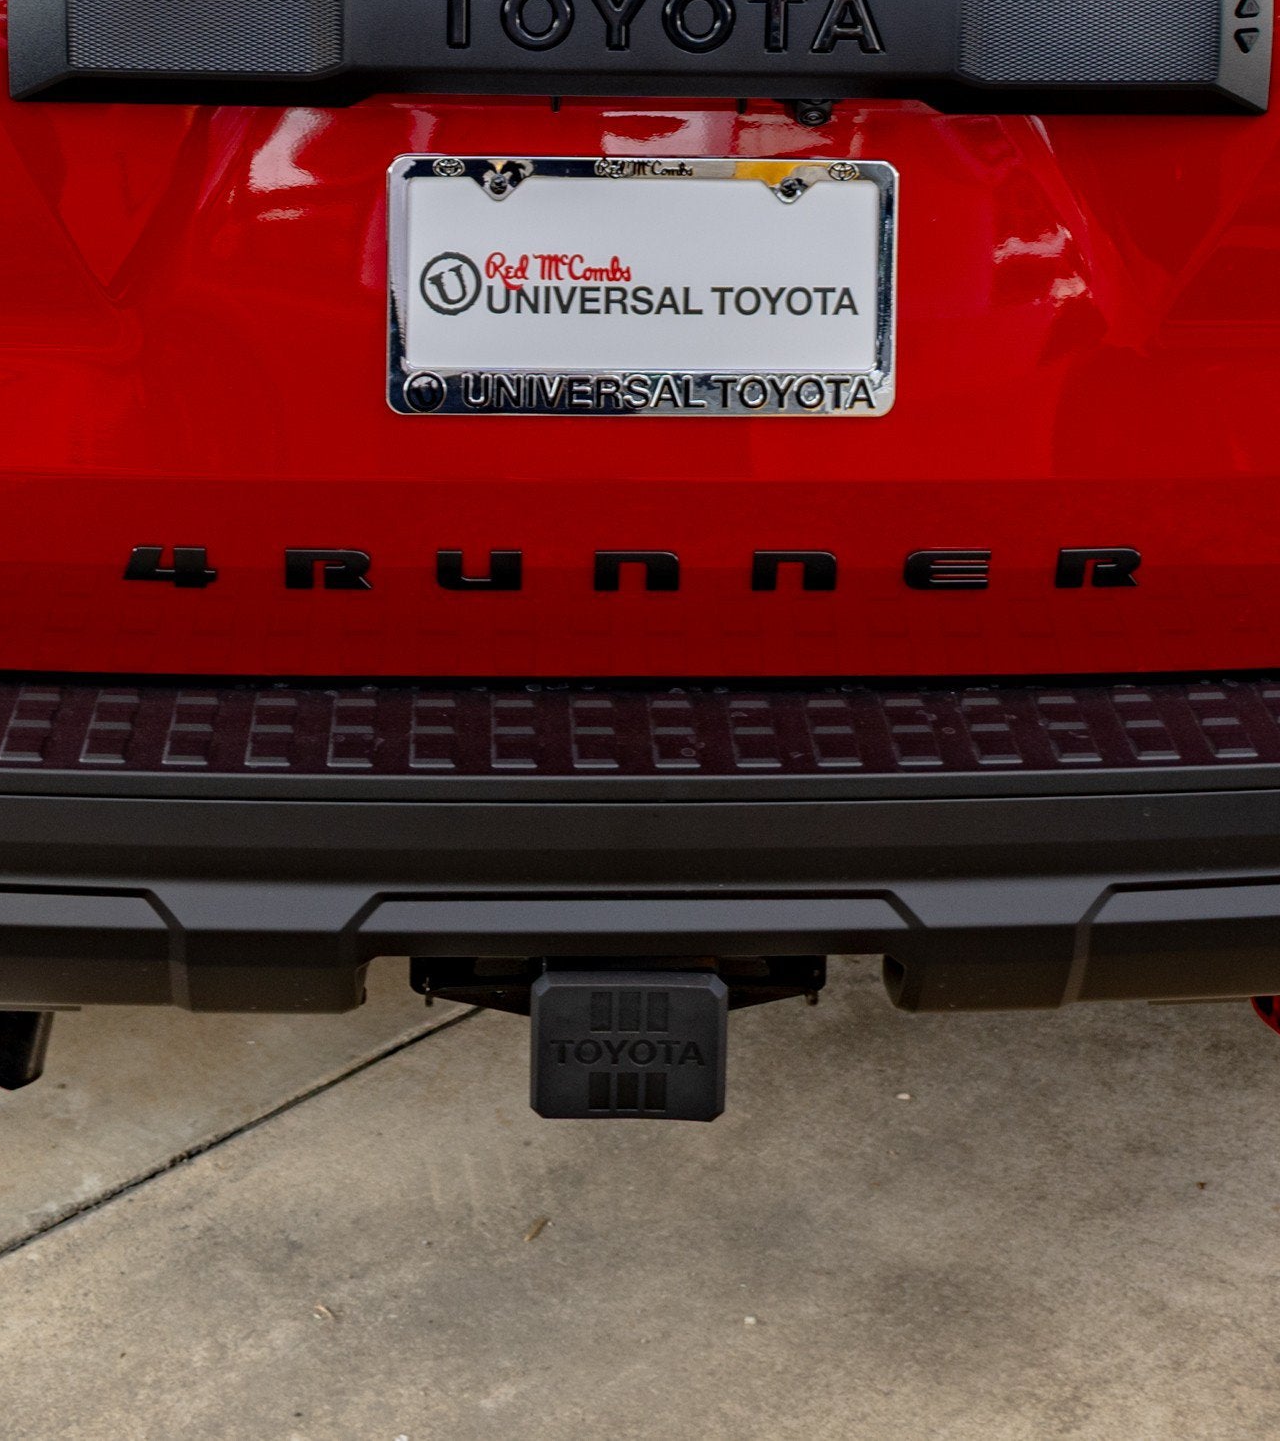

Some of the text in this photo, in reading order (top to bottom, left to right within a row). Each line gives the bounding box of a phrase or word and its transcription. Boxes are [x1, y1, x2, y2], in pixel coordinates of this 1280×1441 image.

[594, 158, 628, 179] Red
[484, 251, 632, 291] Red McCombs
[486, 284, 859, 316] UNIVERSAL TOYOTA
[460, 372, 877, 411] UNIVERSAL TOYOTA
[550, 1038, 706, 1066] TOYOTA
